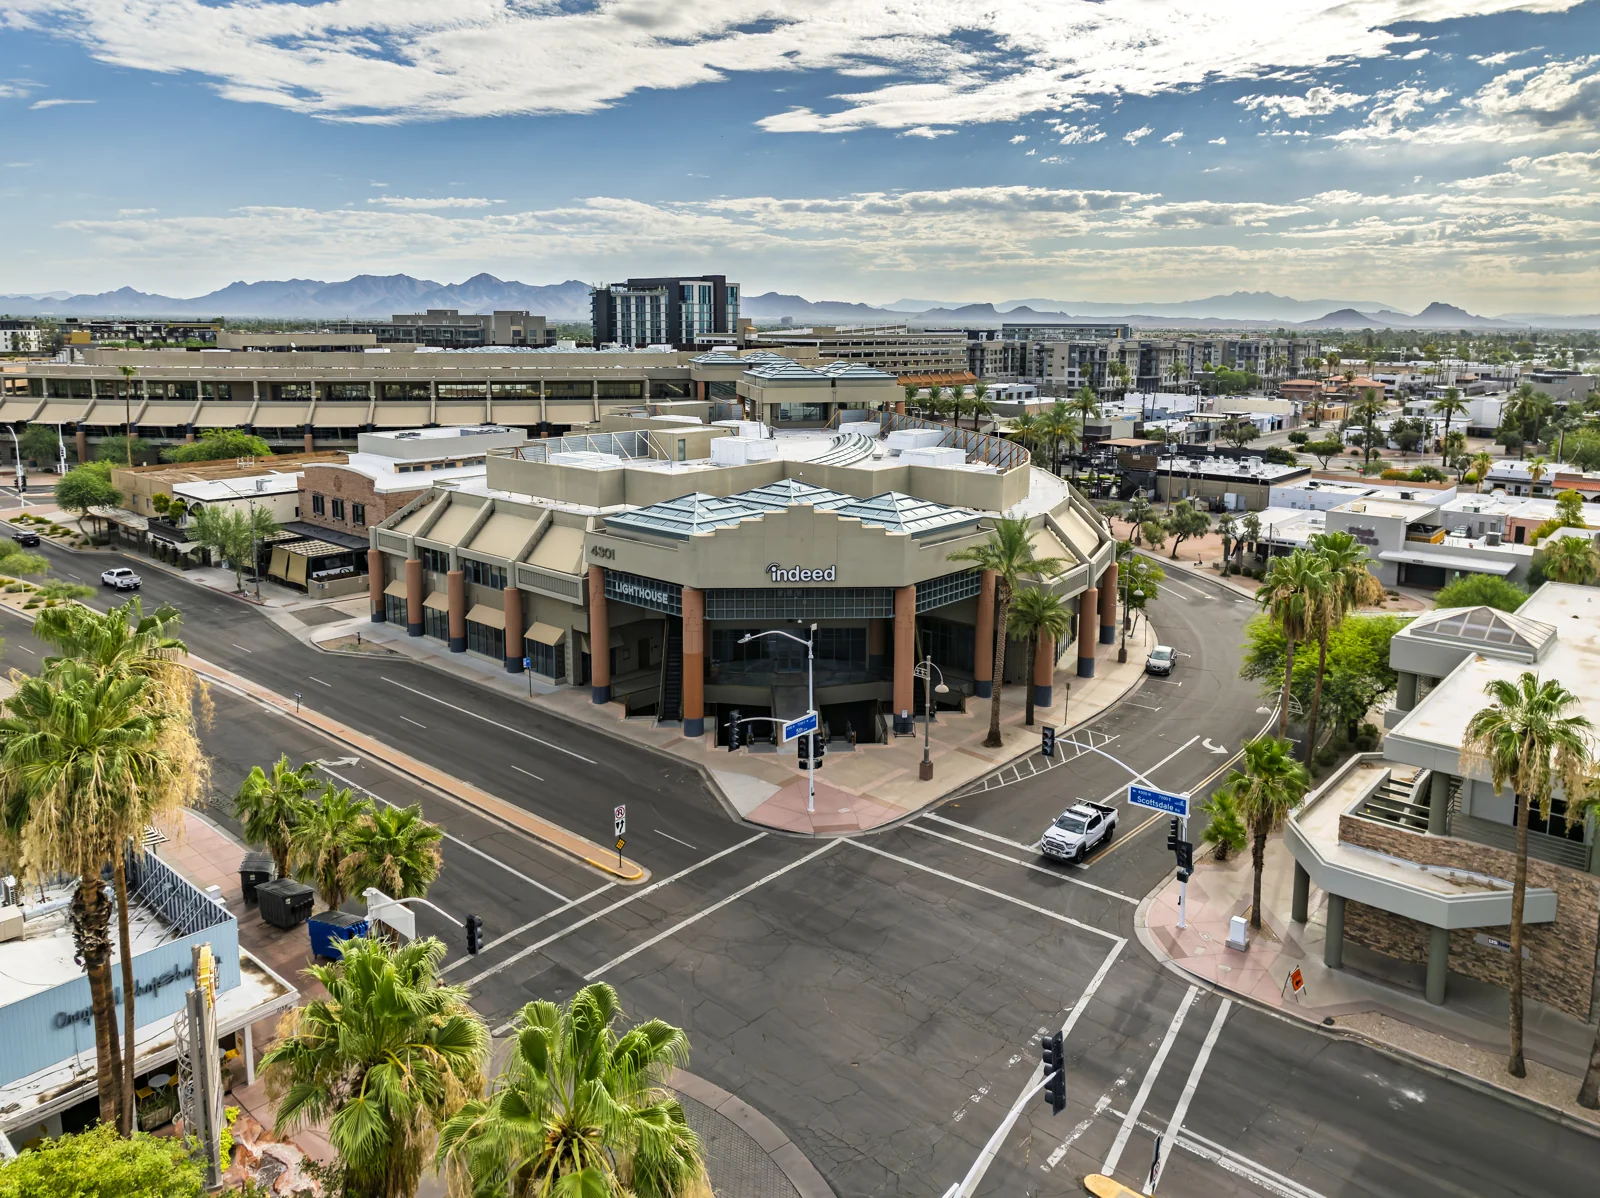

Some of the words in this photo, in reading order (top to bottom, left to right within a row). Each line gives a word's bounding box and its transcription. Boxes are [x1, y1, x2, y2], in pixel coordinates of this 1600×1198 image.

[590, 545, 616, 561] 4301
[766, 563, 836, 582] indeed
[615, 581, 669, 605] LIGHTHOUSE
[1137, 796, 1174, 811] Scottsdale
